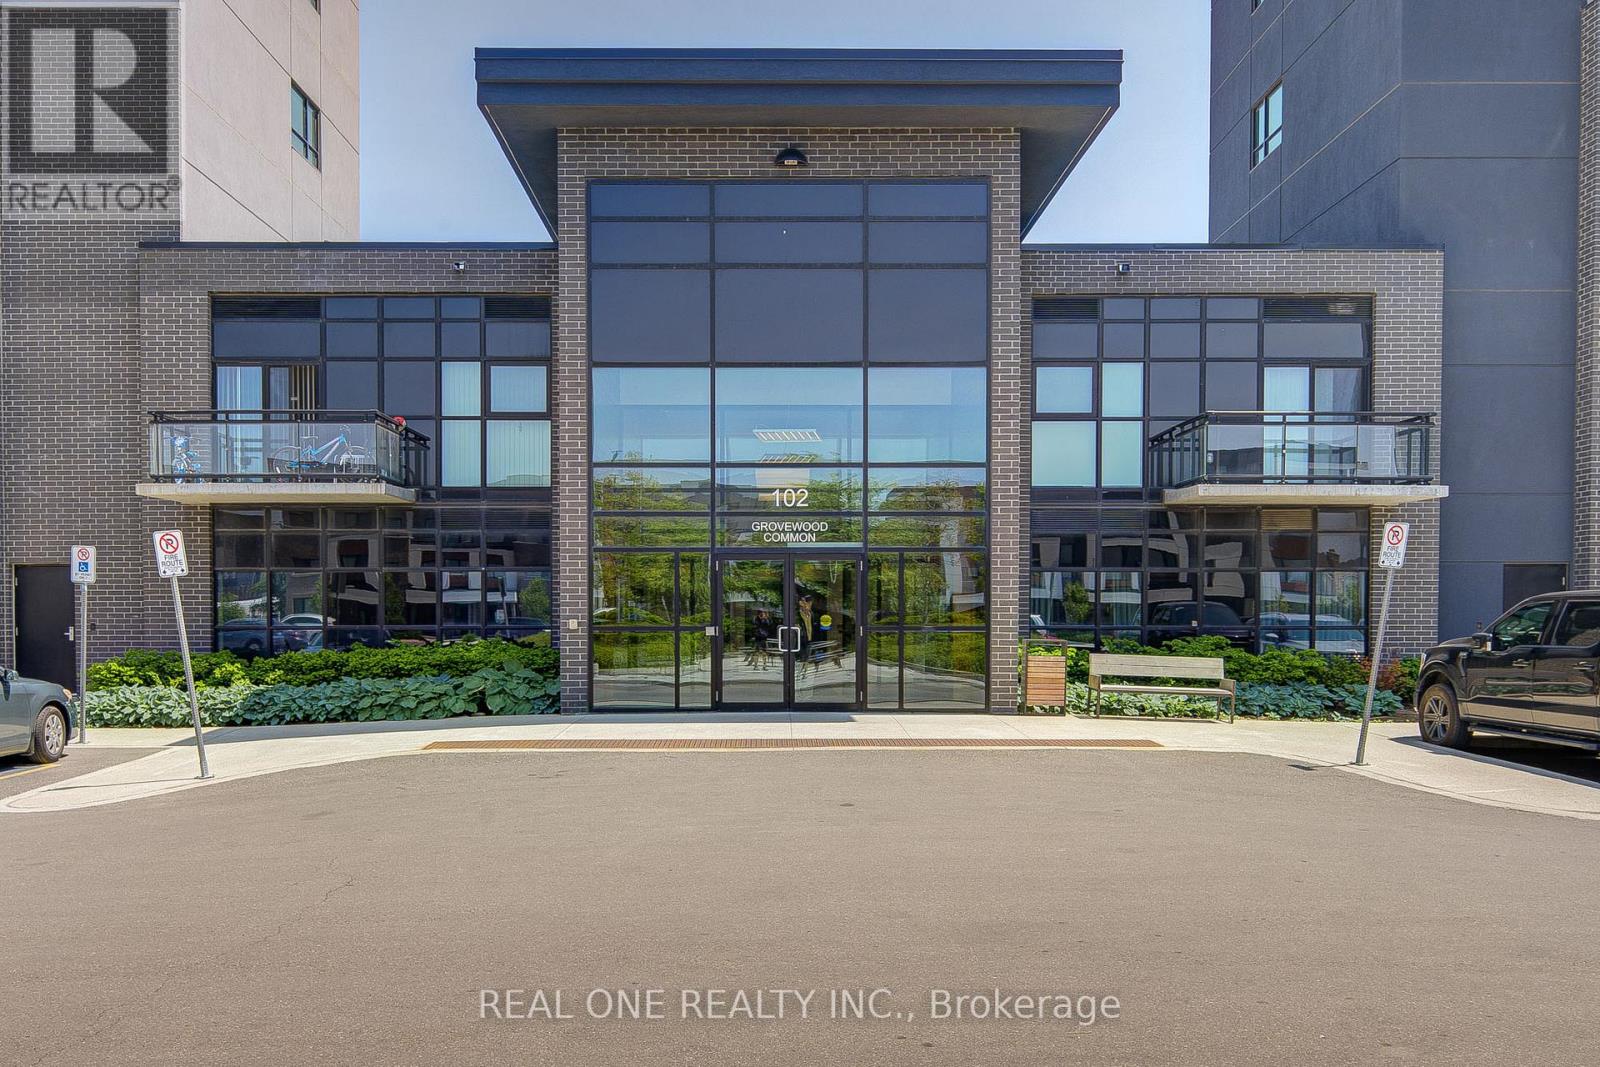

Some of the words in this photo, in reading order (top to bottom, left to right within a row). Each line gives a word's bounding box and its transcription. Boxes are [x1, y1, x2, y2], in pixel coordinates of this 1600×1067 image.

[771, 488, 809, 507] 102
[751, 521, 829, 532] GROVEWOOD
[763, 532, 816, 543] COMMON
